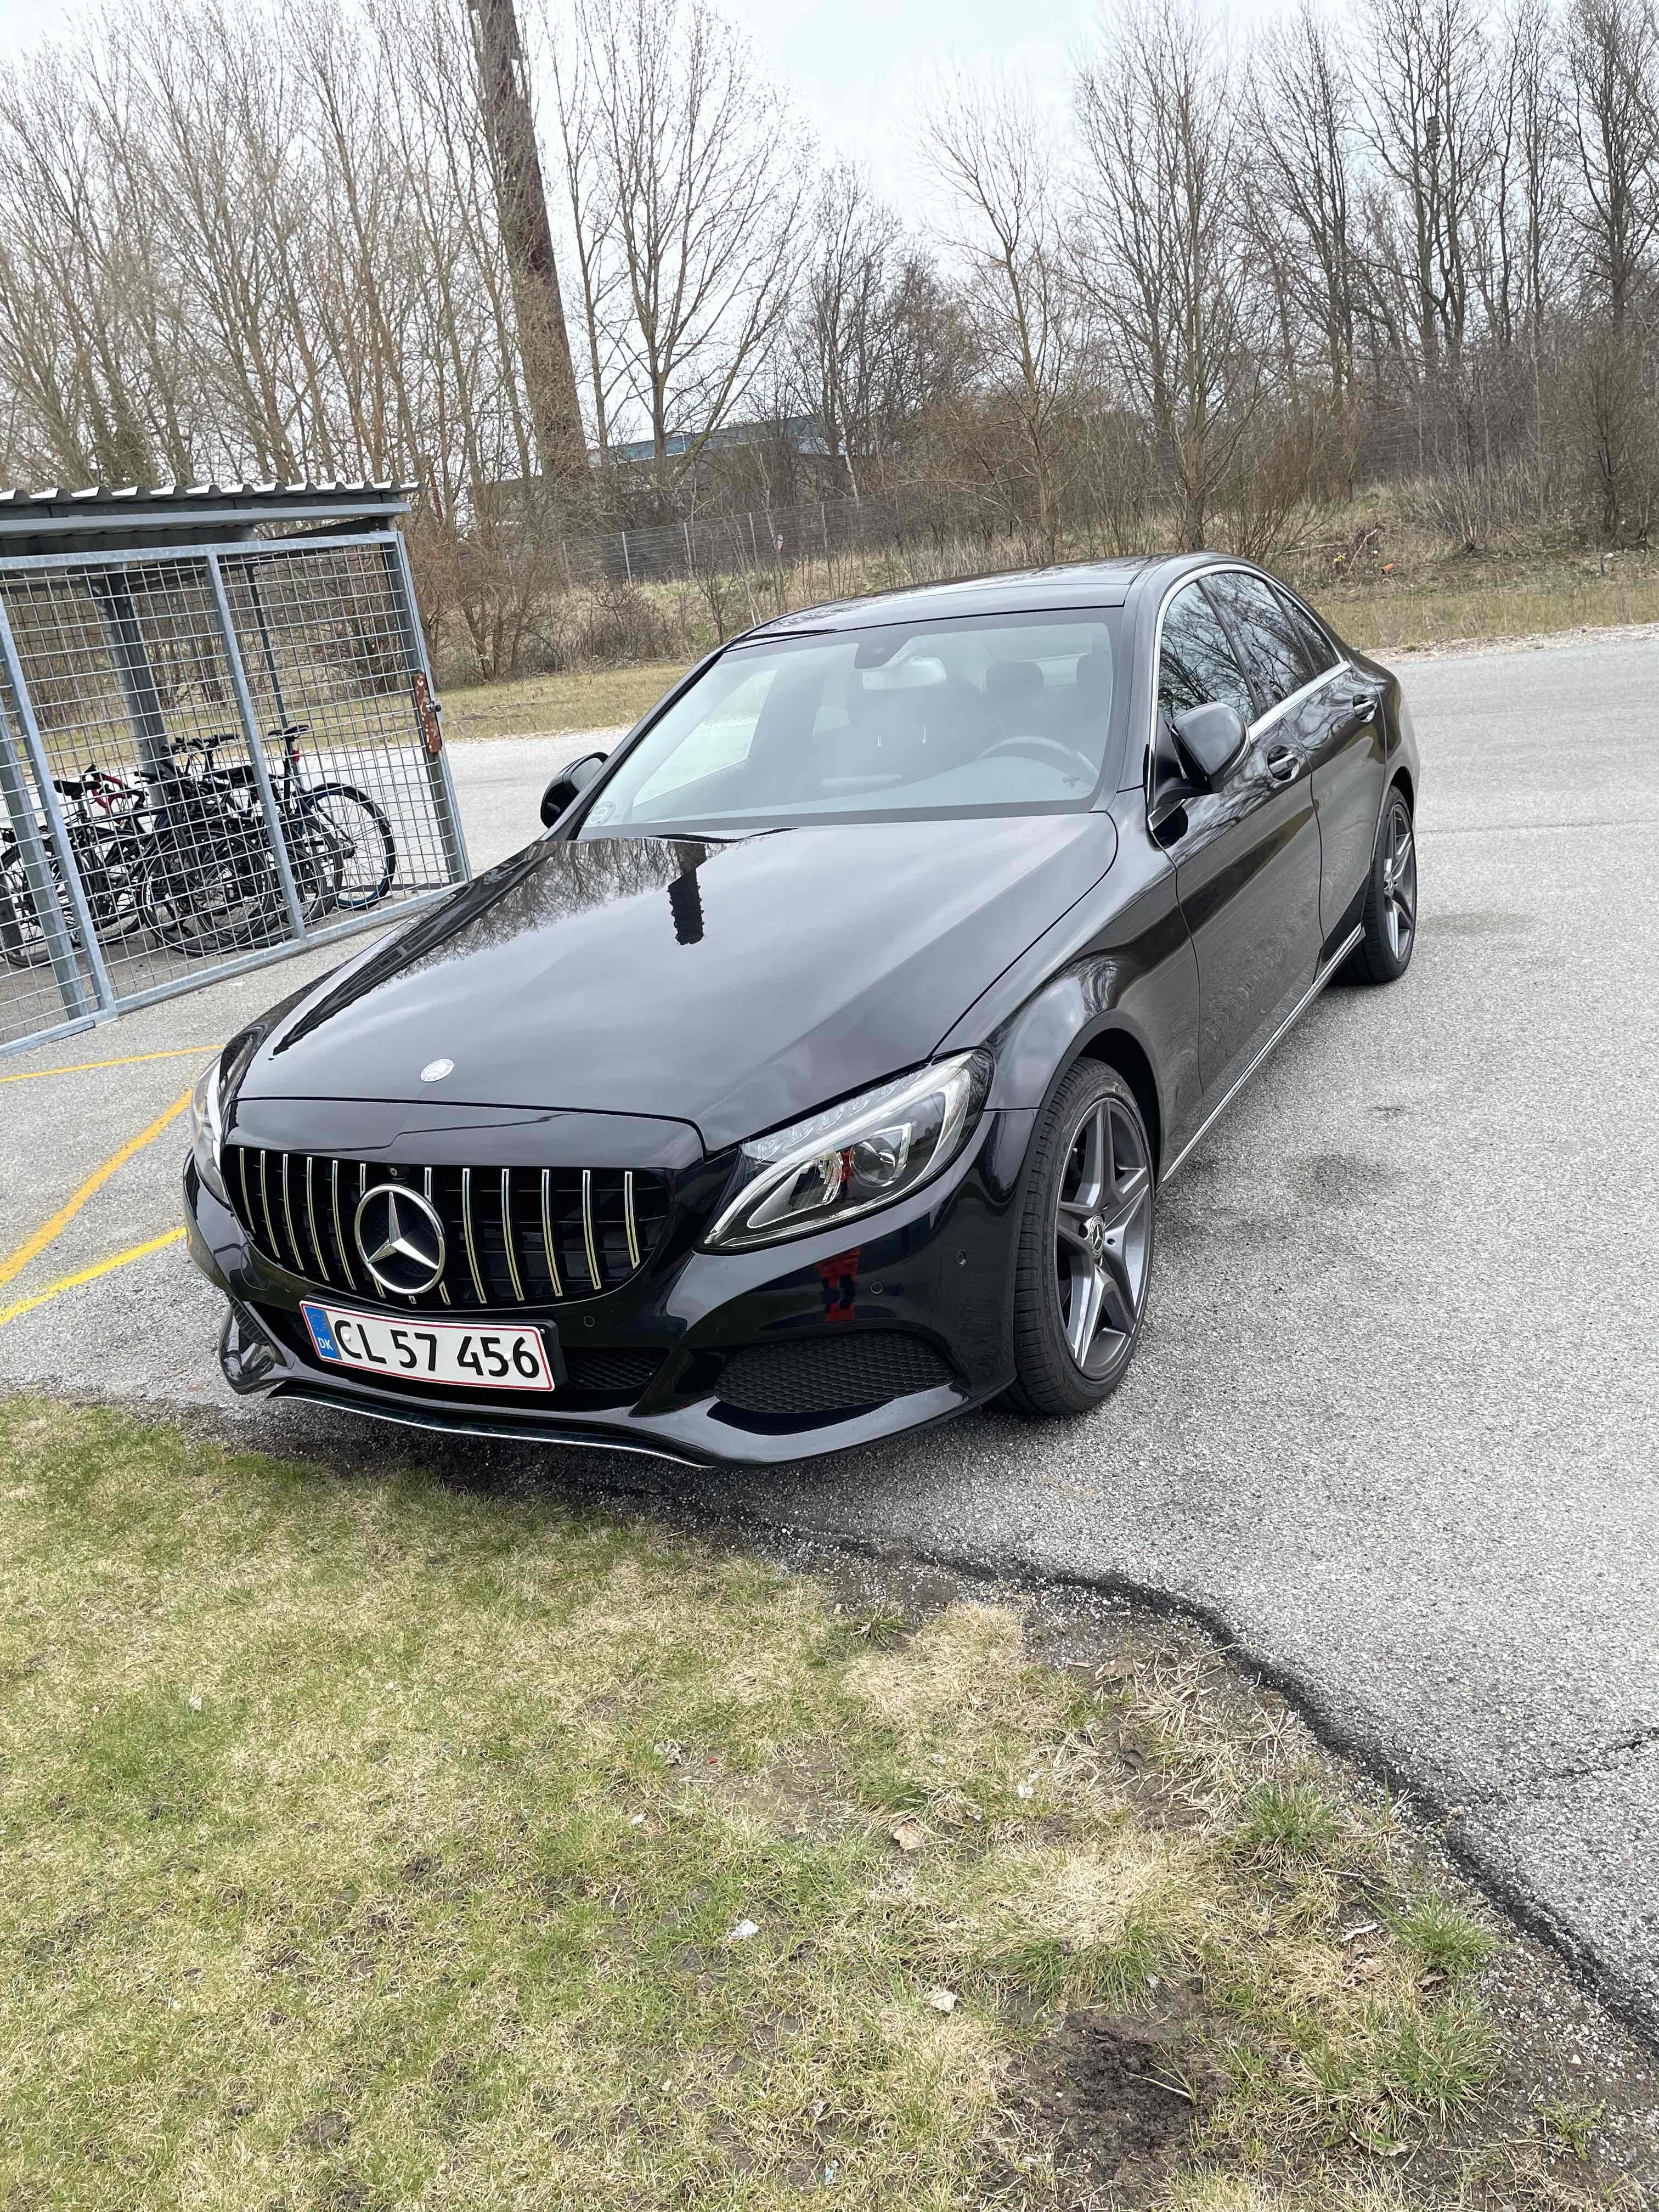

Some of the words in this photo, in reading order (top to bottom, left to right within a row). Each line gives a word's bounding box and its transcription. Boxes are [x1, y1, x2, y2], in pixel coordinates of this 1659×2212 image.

[317, 1338, 333, 1351] DK
[334, 1320, 387, 1364] CL
[390, 1329, 437, 1371] 57
[457, 1336, 540, 1378] 456
